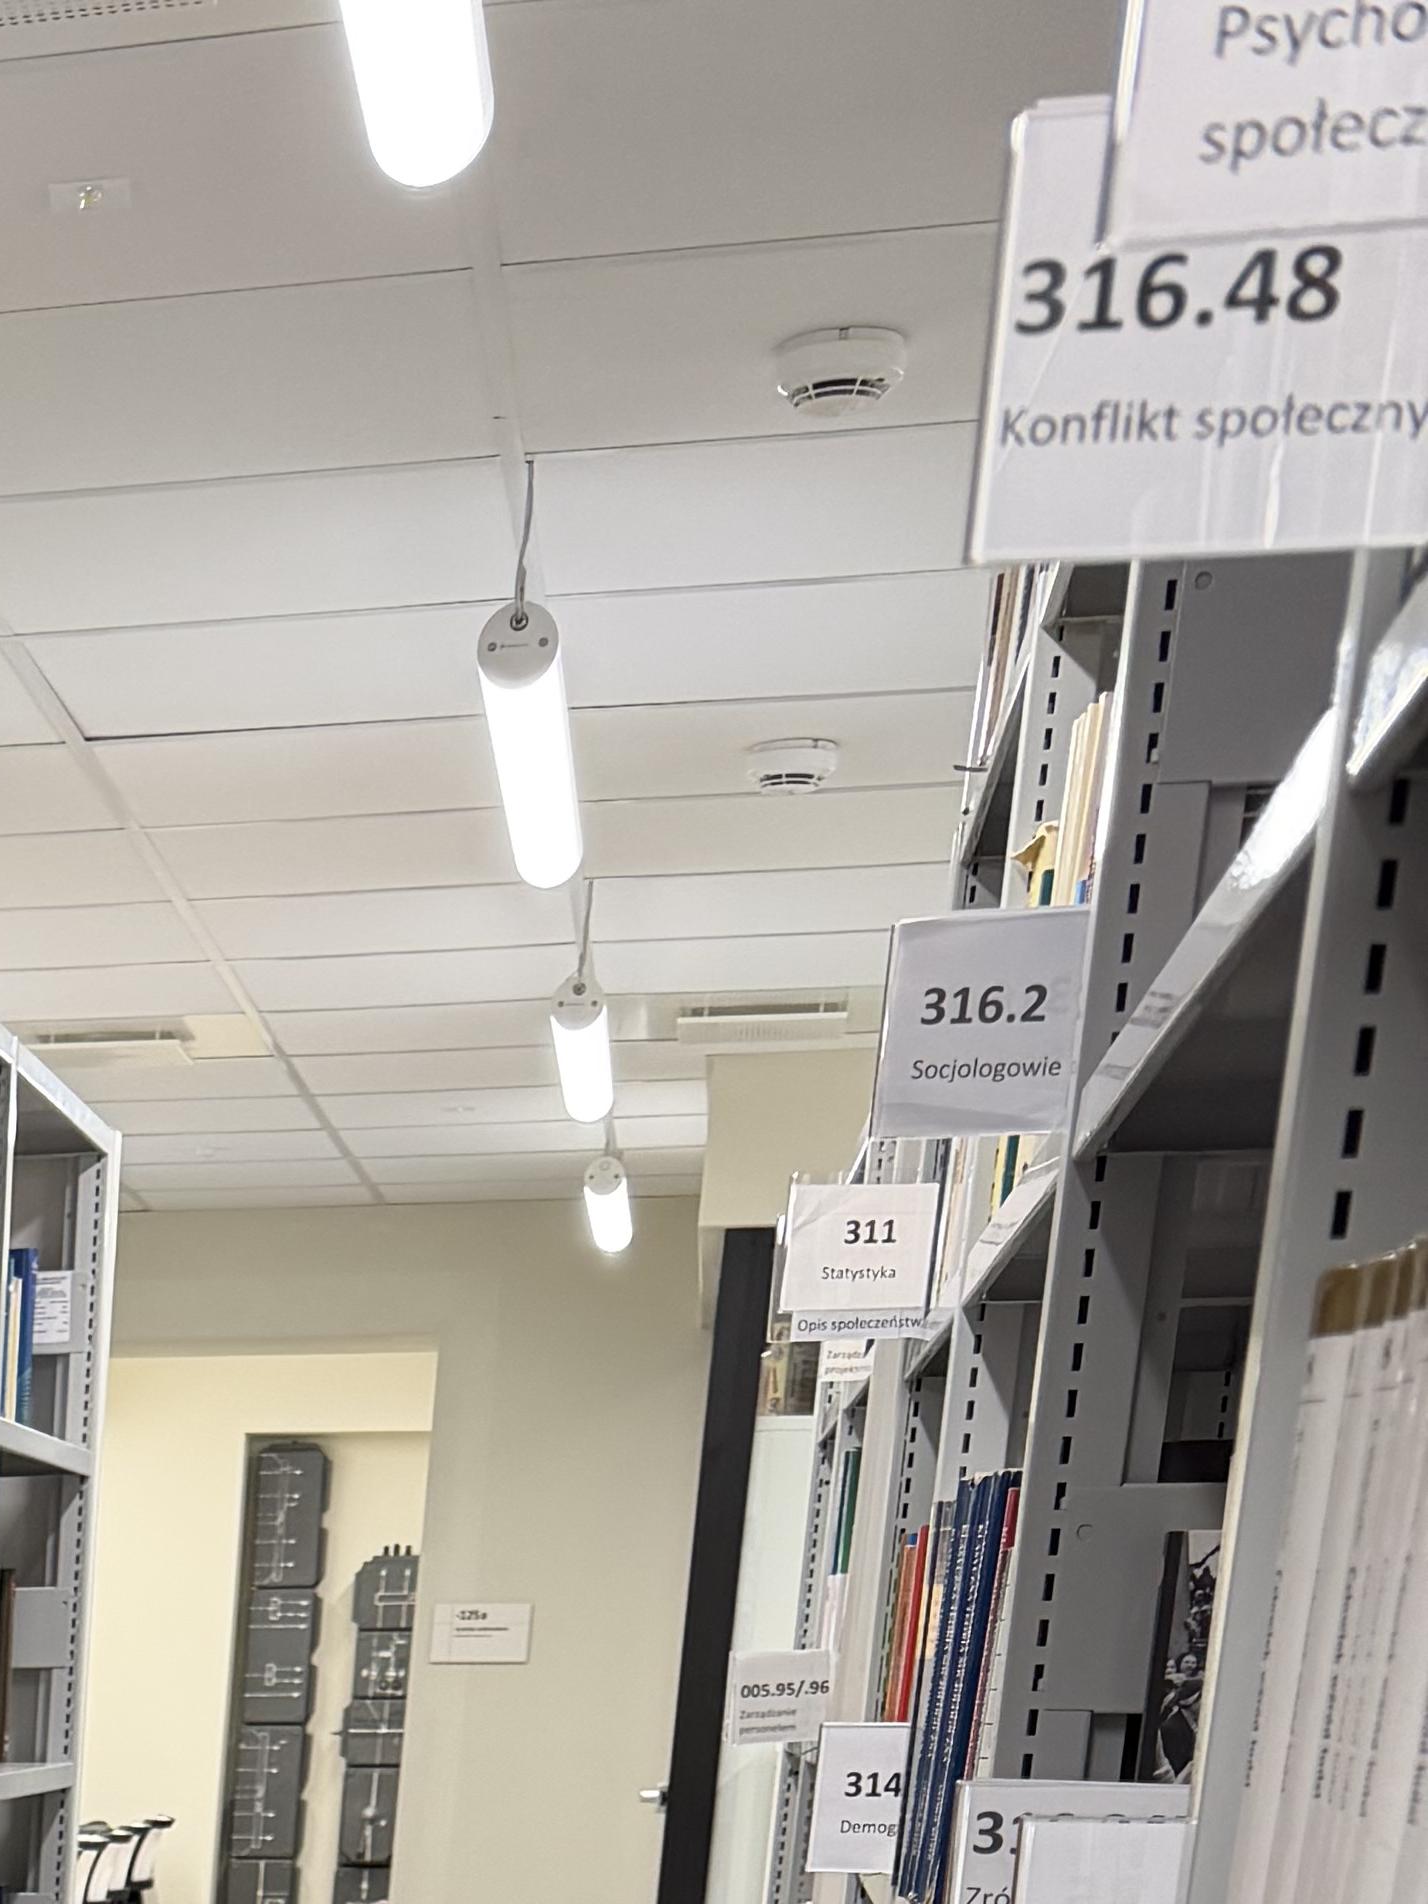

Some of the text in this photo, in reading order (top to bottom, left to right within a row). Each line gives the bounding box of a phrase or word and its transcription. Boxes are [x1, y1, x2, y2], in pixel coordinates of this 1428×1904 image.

[1213, 0, 1428, 65] Psycho
[1198, 98, 1428, 172] społecz
[1013, 243, 1343, 336] 316.48
[999, 392, 1428, 447] Konflikt społeczny
[920, 984, 1048, 1026] 316.2
[910, 1055, 1063, 1083] Socjologowie
[843, 1219, 897, 1244] 311
[821, 1266, 897, 1282] Statystyka
[797, 1316, 923, 1332] Opis społeczeństw
[740, 1680, 831, 1700] 005.95/.96
[844, 1772, 902, 1798] 314
[839, 1819, 898, 1838] Demog
[972, 1810, 1017, 1856] 3
